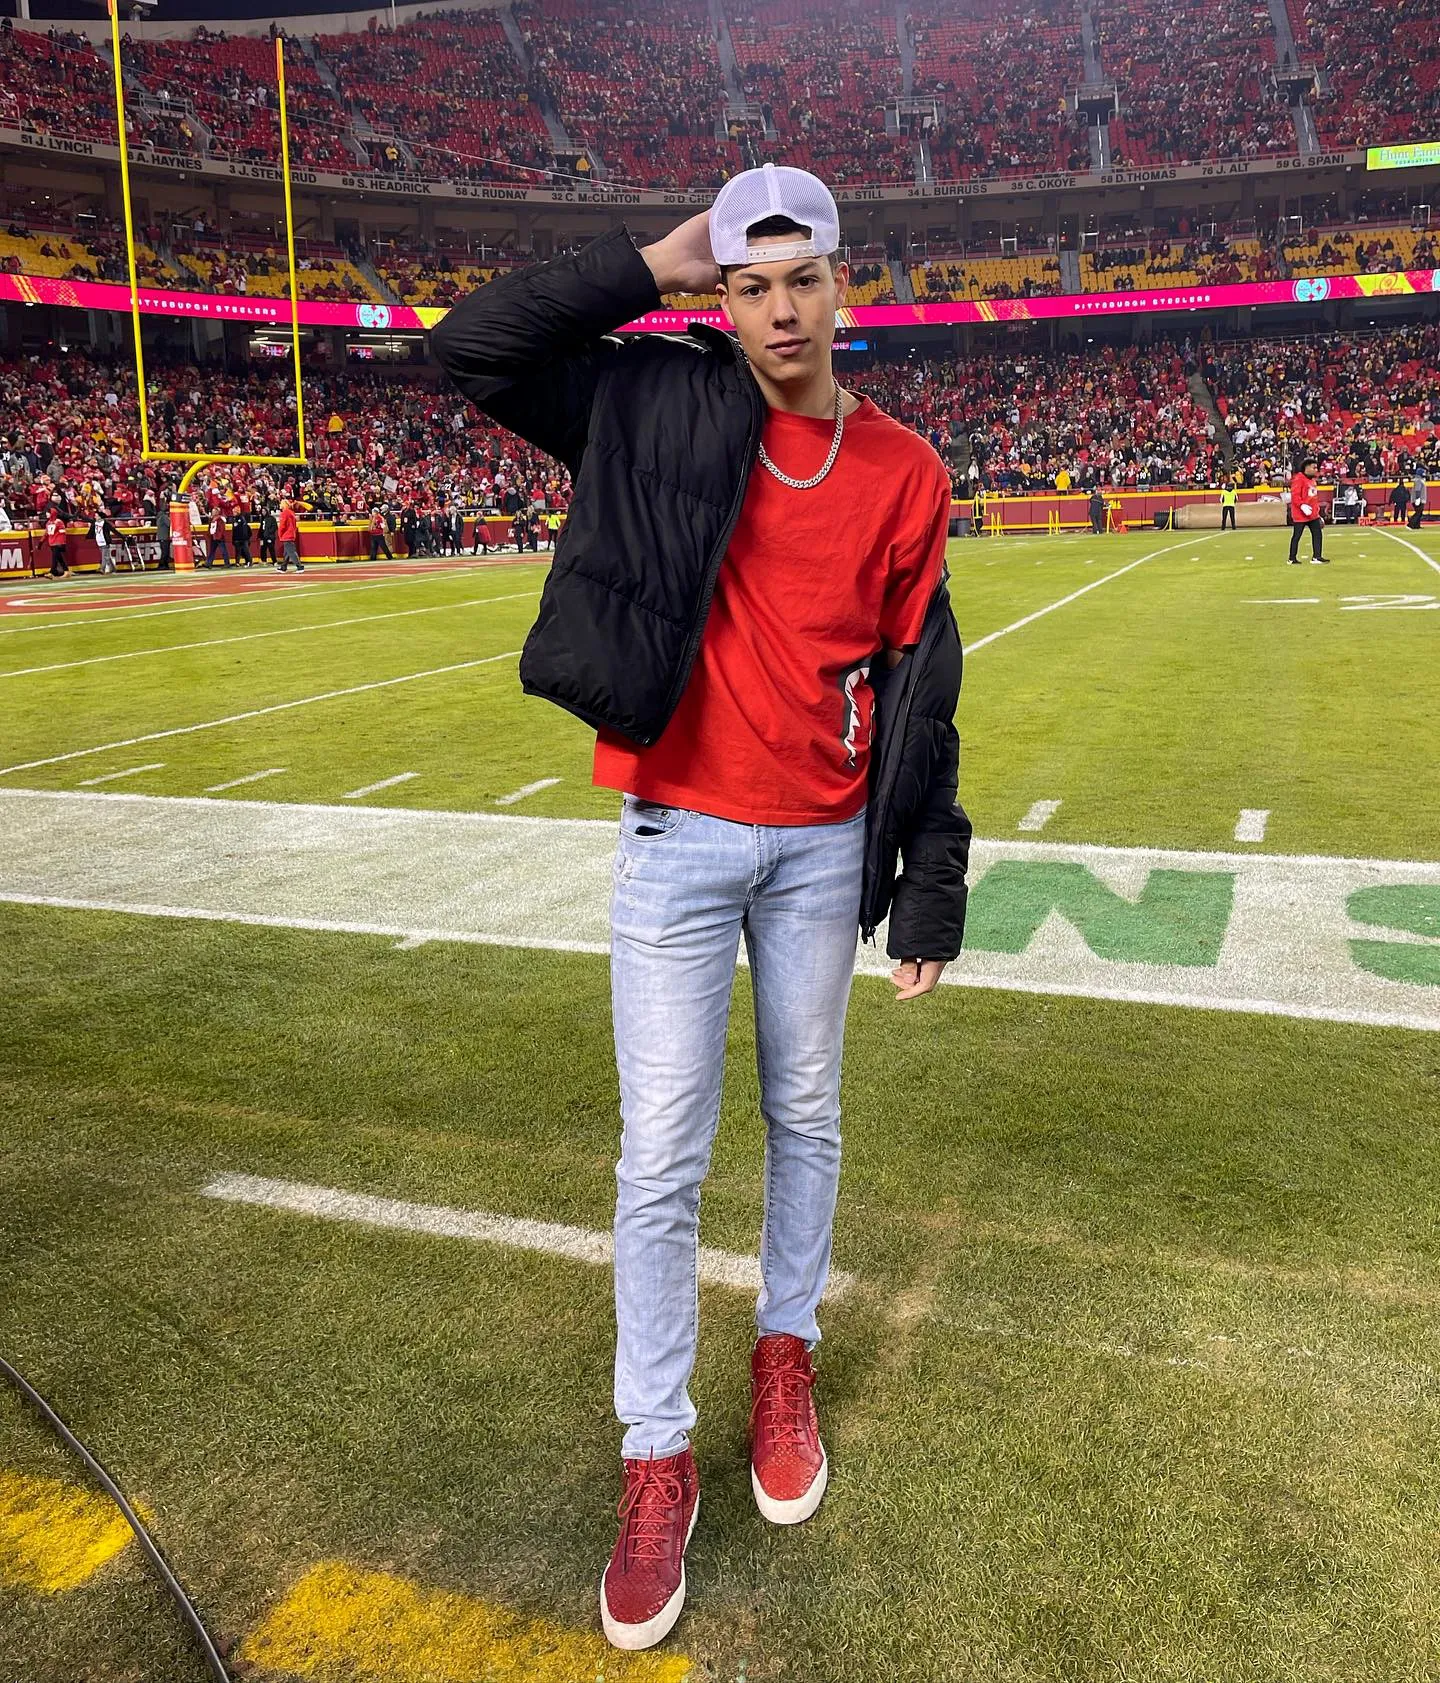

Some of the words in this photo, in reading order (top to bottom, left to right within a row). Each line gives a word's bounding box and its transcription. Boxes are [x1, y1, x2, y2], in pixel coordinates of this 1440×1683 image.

[21, 135, 33, 145] 51
[35, 136, 47, 147] J.
[50, 139, 94, 155] LYNCH
[137, 152, 149, 163] A.
[151, 153, 203, 170] HAYNES
[1276, 160, 1289, 169] 59
[1308, 154, 1345, 167] SPANI
[229, 165, 236, 174] 3
[239, 165, 249, 176] J.
[251, 167, 317, 183] STENRUD
[1216, 165, 1227, 175] J.
[1229, 163, 1250, 174] ALT
[342, 177, 355, 187] 69
[357, 179, 368, 189] S.
[370, 180, 431, 194] HEADRICK
[908, 188, 920, 197] 34
[922, 187, 932, 197] L.
[934, 184, 988, 196] BURRUSS
[1011, 182, 1024, 191] 35
[1026, 180, 1037, 190] C.
[1039, 178, 1077, 189] OKOYE
[455, 187, 468, 196] 58
[470, 188, 480, 198] J.
[482, 188, 528, 200] RUDNAY
[551, 192, 563, 201] 32
[565, 192, 576, 202] C.
[578, 193, 640, 203] McCLINTON
[664, 195, 676, 203] 20
[855, 190, 885, 200] STILL
[1074, 299, 1147, 310] PITTSBURGH
[1152, 295, 1210, 306] STEELERS
[216, 305, 277, 316] STEELERS
[652, 317, 677, 325] CITY
